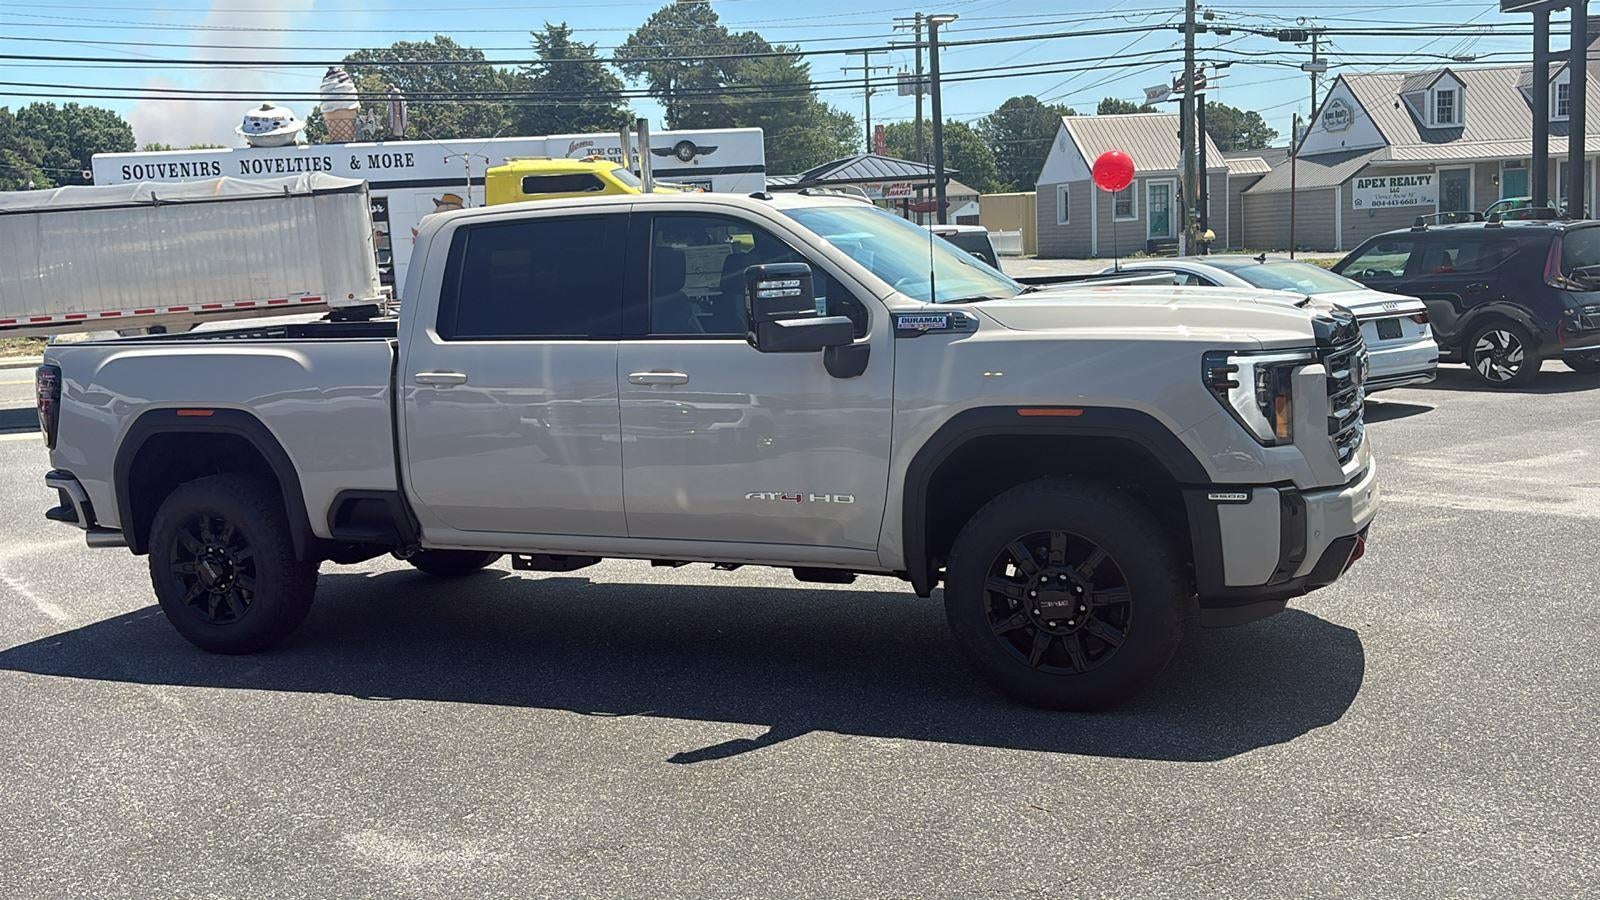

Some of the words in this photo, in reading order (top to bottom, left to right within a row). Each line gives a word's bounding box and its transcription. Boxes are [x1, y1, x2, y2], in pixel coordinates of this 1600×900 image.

[122, 161, 221, 180] SOUVENIRS
[240, 156, 332, 175] NOVELTIES
[350, 155, 361, 169] &
[368, 153, 415, 168] MORE
[1357, 178, 1386, 189] APEX
[1390, 175, 1431, 187] REALTY
[809, 493, 855, 504] HD
